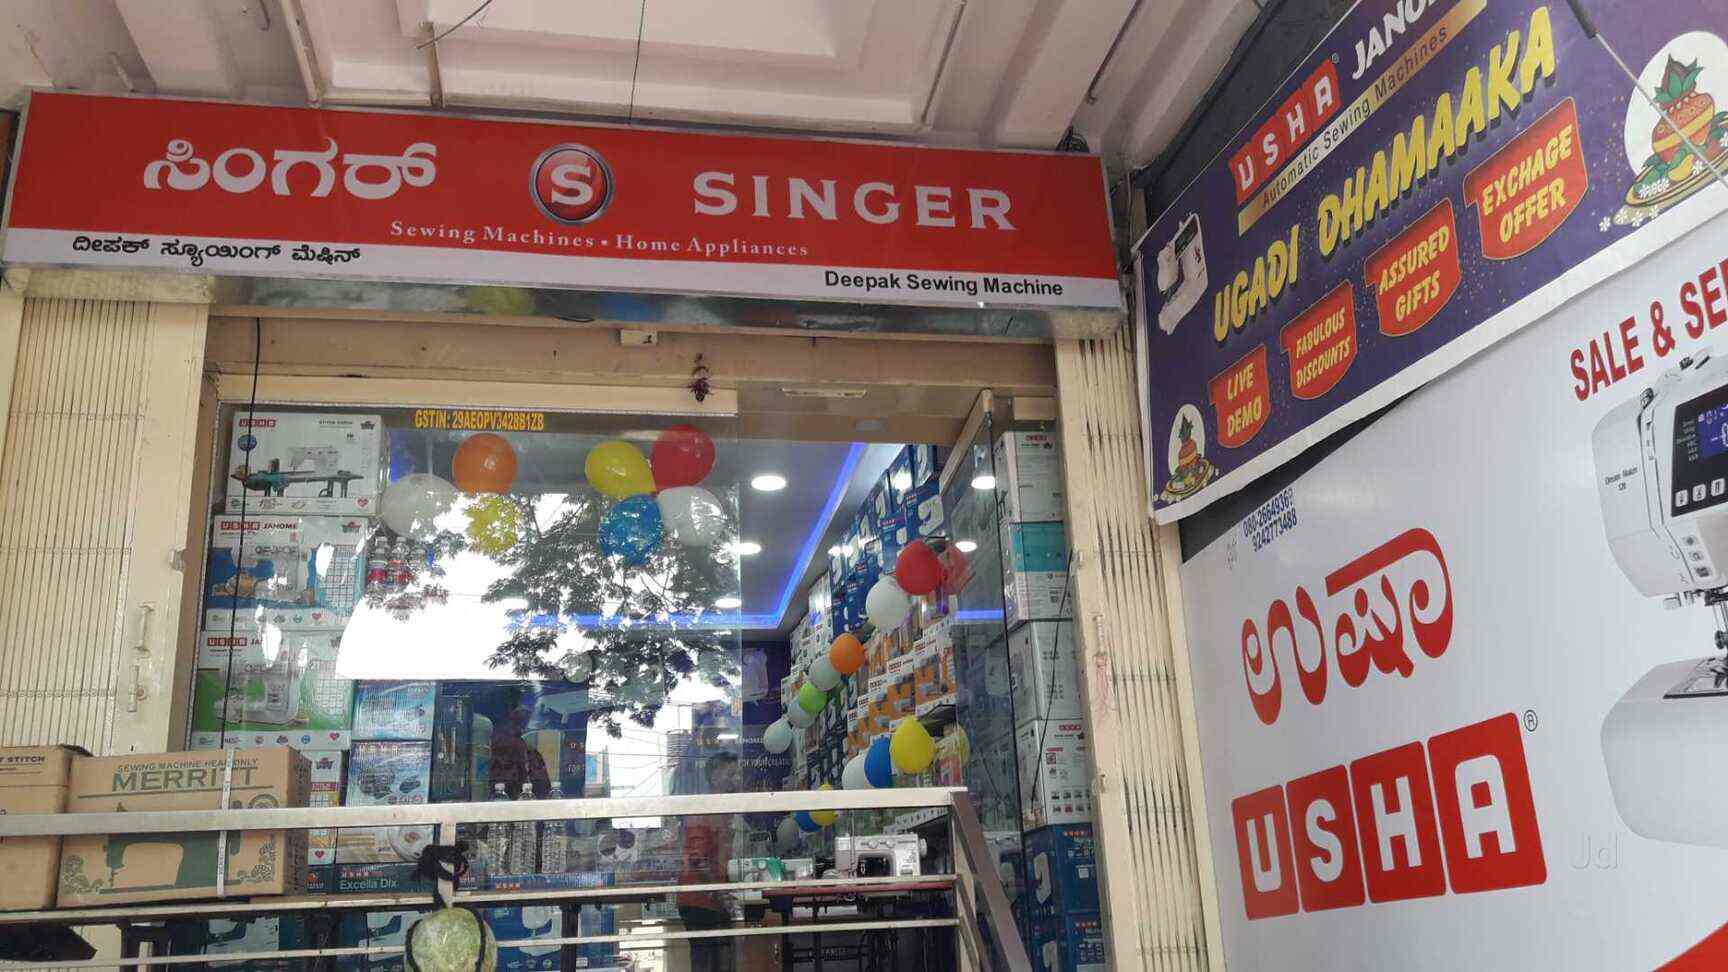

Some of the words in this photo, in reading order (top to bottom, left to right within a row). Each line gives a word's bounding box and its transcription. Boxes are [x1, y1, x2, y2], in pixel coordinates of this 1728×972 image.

[1236, 74, 1334, 193] USHA
[1352, 0, 1438, 79] JANO
[1262, 144, 1319, 208] Automatic
[1323, 99, 1372, 149] Sewing
[1374, 27, 1447, 101] Machines
[143, 136, 437, 200] ಸಿಂಗರ್
[549, 163, 594, 207] S
[1213, 224, 1299, 342] UGADI
[1318, 6, 1556, 257] DHAMAAKA
[1482, 124, 1573, 216] EXCHAGE
[693, 171, 1017, 231] SINGER
[1500, 177, 1568, 243] OFFER
[72, 235, 150, 254] ದೀಪಕ್
[390, 221, 475, 243] Sewing
[483, 226, 595, 247] Machines
[616, 234, 681, 251] Home
[687, 237, 808, 257] Appliances
[1379, 225, 1450, 296] ASSURED
[824, 270, 901, 291] Deepak
[906, 273, 979, 296] Sewing
[983, 277, 1064, 296] Machine
[1395, 270, 1441, 322] GIFTS
[1296, 306, 1346, 358] FABULOUS
[1570, 315, 1645, 402] SALE
[1650, 301, 1676, 358] &
[1227, 363, 1255, 400] LIVE
[1296, 335, 1351, 389] DISCOUNTS
[1227, 395, 1262, 438] DEMO
[7, 755, 46, 764] STITCH
[1242, 751, 1519, 895] USHA
